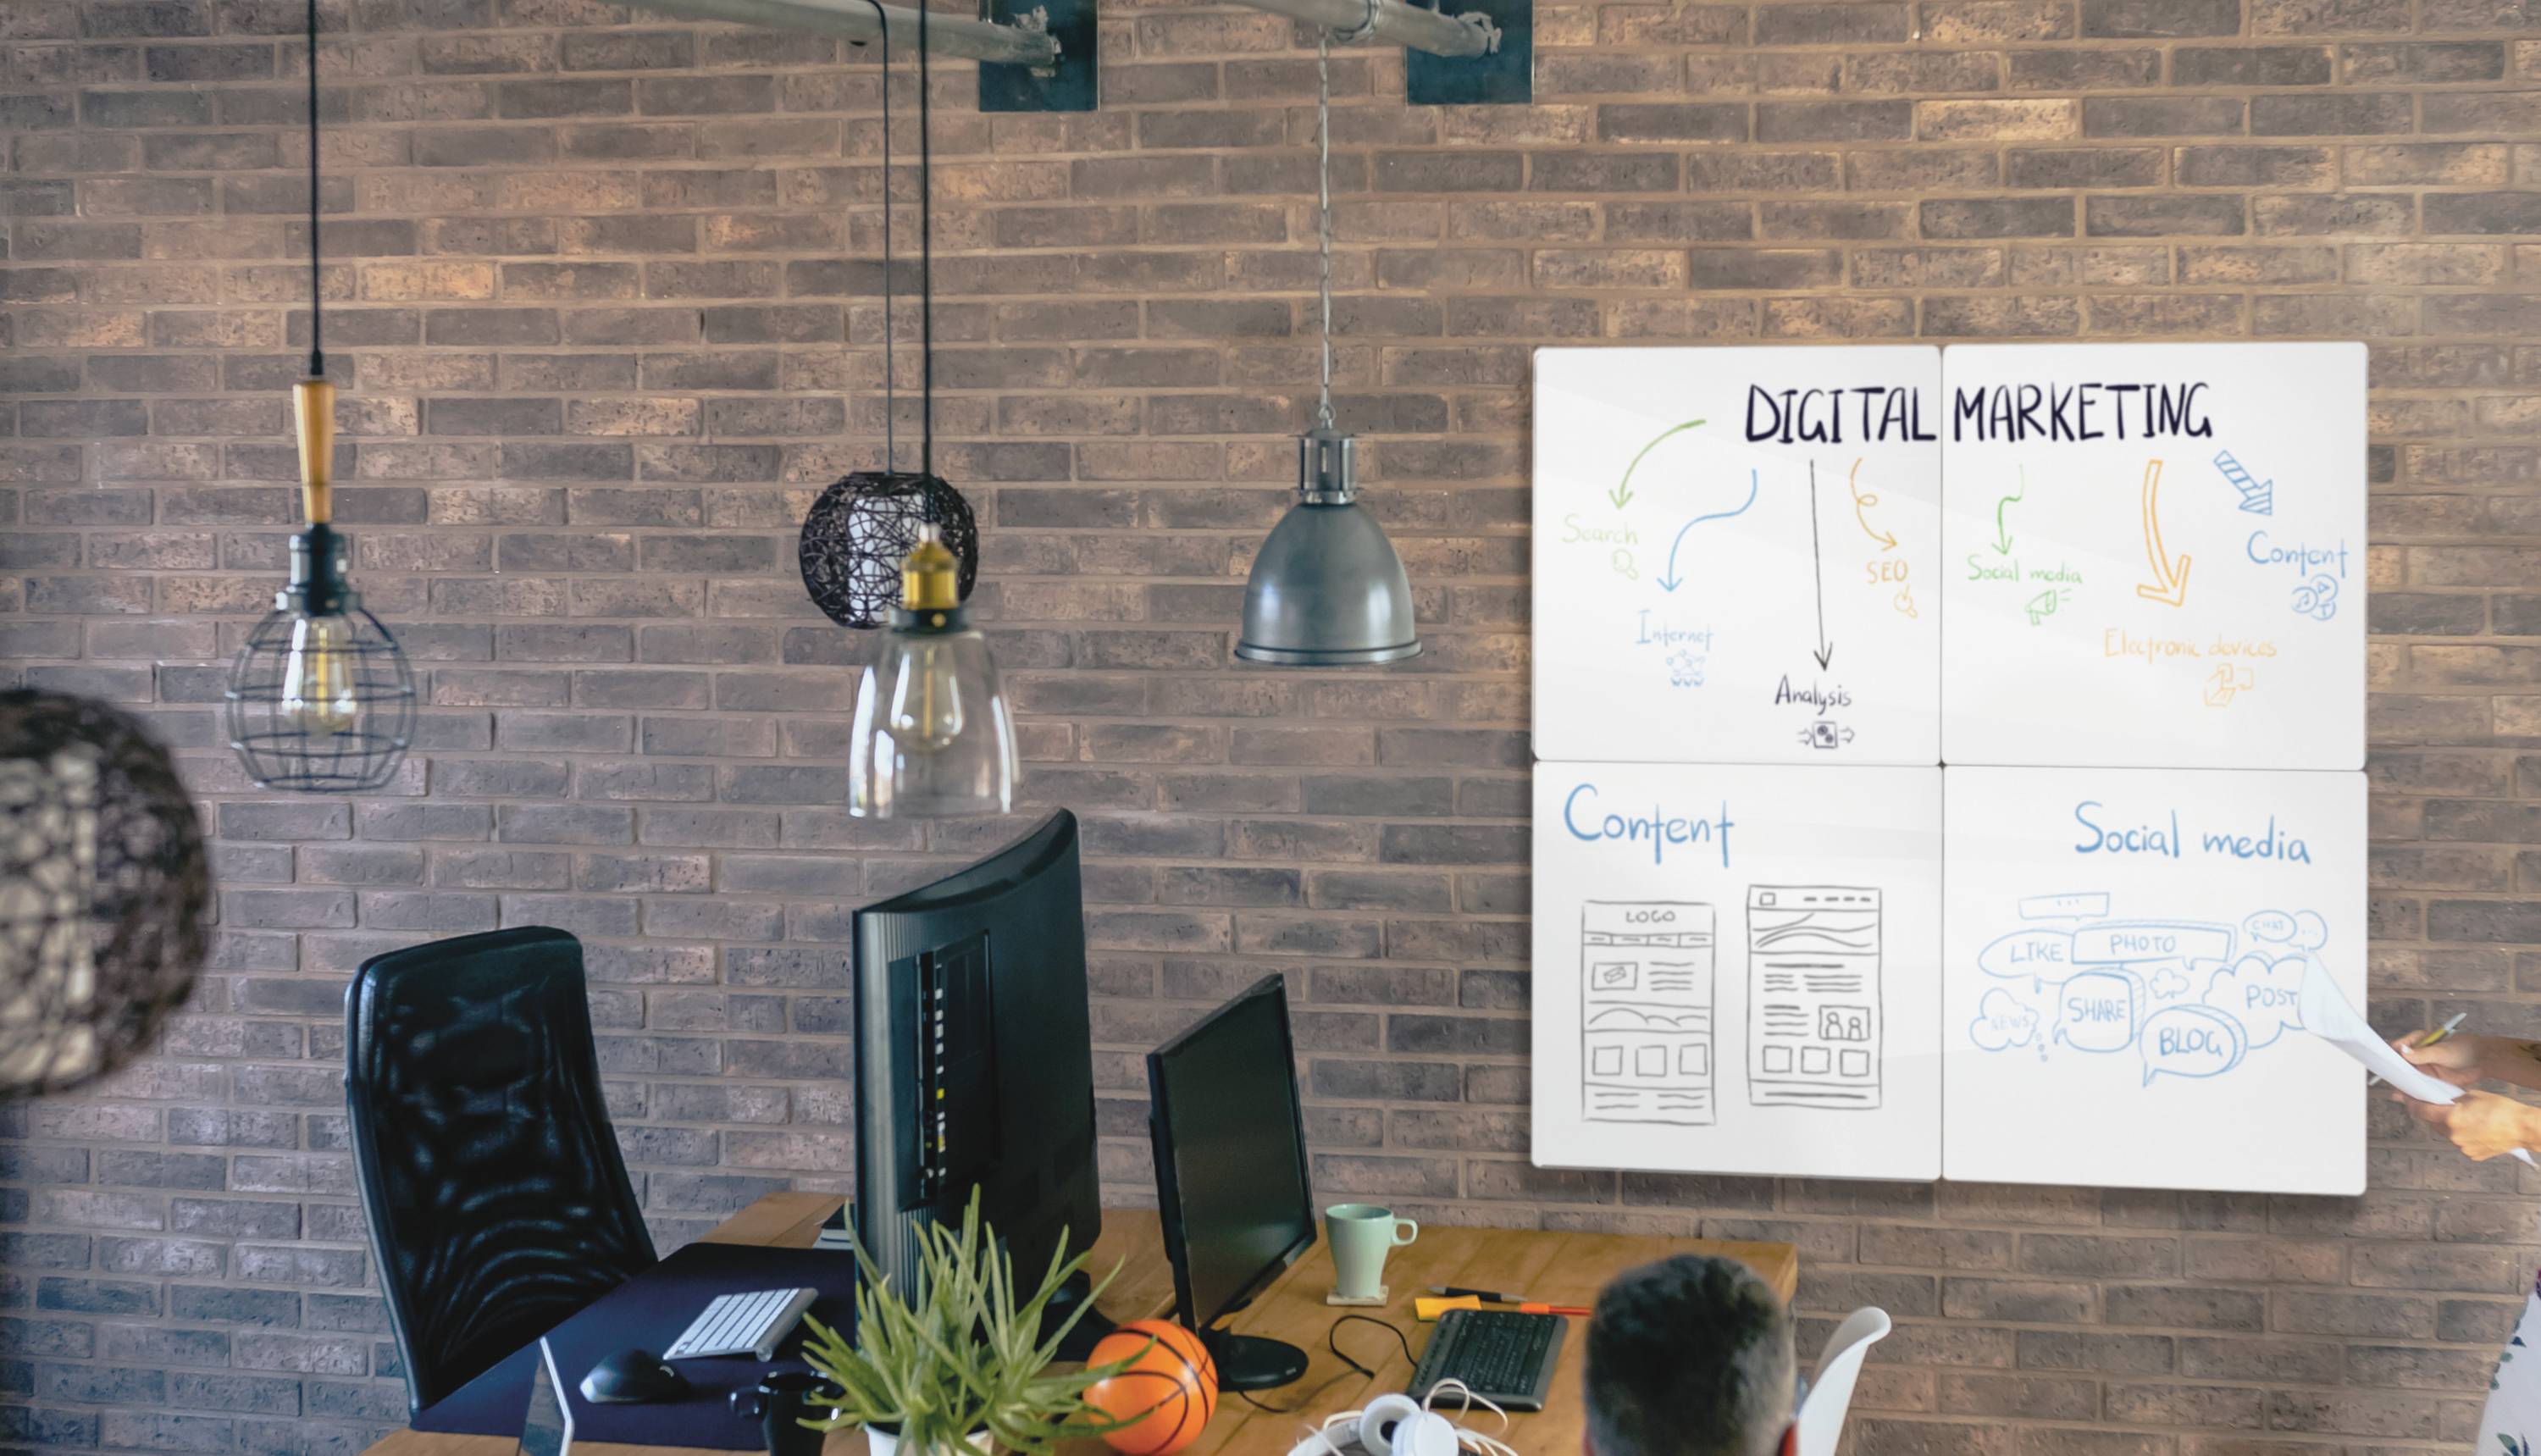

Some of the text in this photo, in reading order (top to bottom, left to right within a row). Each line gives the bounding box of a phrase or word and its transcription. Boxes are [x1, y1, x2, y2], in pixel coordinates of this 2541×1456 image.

[1745, 382, 2213, 444] DIGITAL MARKETING
[1560, 513, 1639, 545] Search
[1966, 552, 2084, 584] Social media
[2246, 530, 2350, 579] Content
[1866, 559, 1909, 585] SEO
[1635, 609, 1714, 652] Internet
[2103, 627, 2278, 664] Electronic devices
[1774, 674, 1852, 717] Analysis
[1564, 783, 1735, 869] Content
[2073, 800, 2312, 865] Social media
[1625, 910, 1677, 924] LOGO
[2251, 919, 2284, 932] CHAT
[2009, 941, 2065, 965] LIKE
[2109, 933, 2178, 956] PHOTO
[2066, 997, 2128, 1024] SHARE
[2245, 983, 2299, 1010] POST
[1990, 1014, 2031, 1032] NEWS
[2158, 1027, 2224, 1058] BLOG
